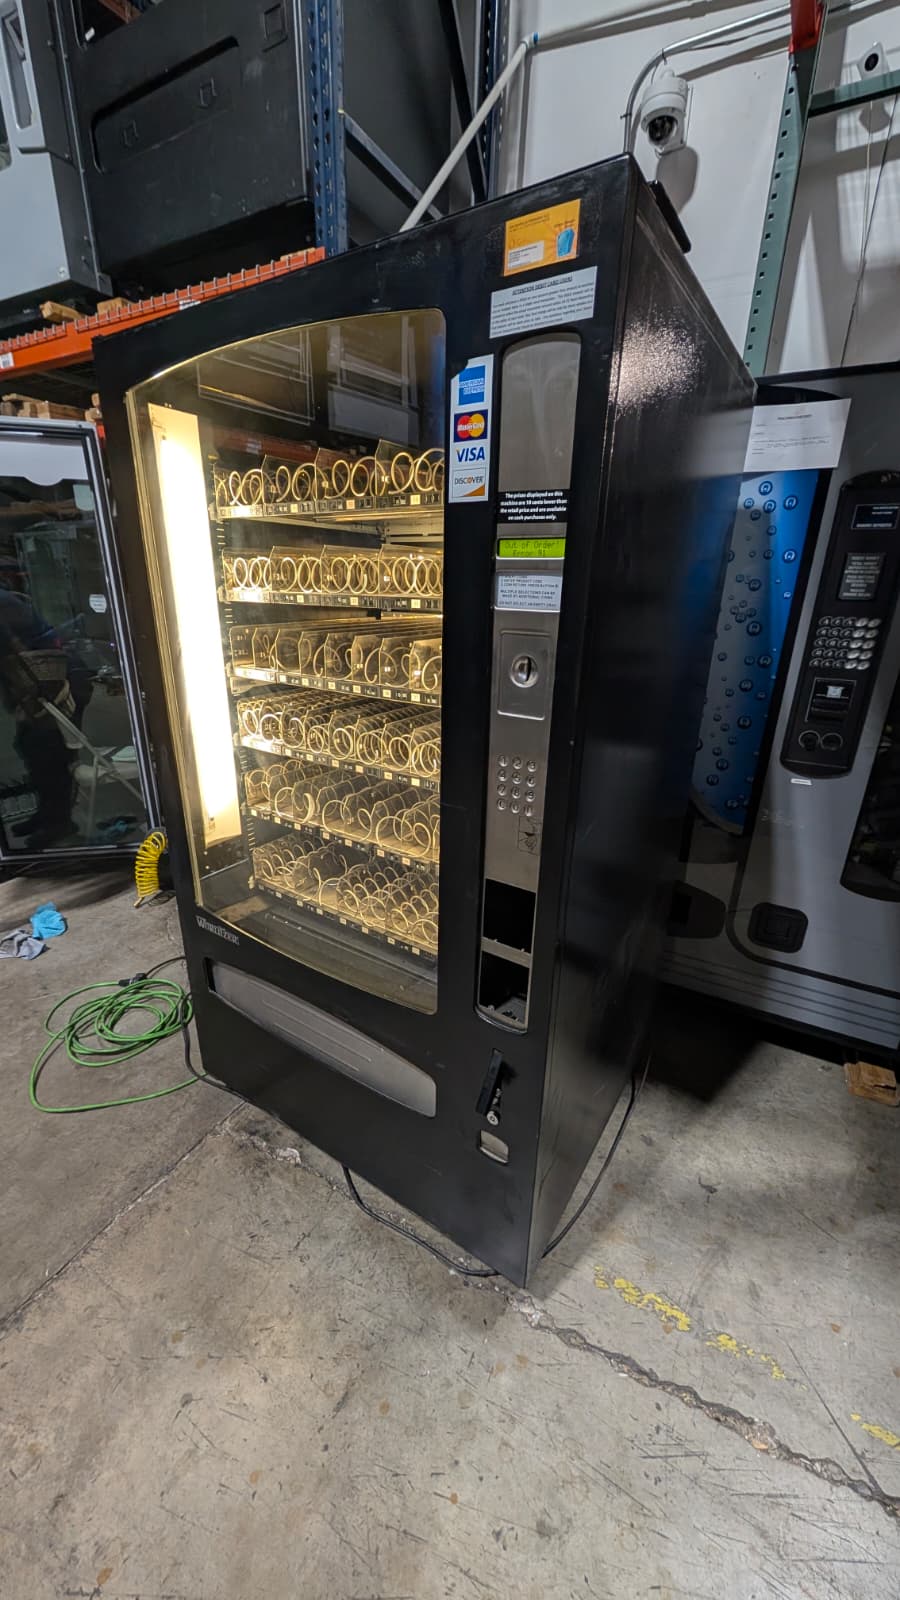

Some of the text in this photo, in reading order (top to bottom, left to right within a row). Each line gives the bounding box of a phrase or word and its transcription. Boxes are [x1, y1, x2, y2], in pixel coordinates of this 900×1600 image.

[457, 421, 485, 432] MasterCard
[456, 446, 485, 462] VISA
[455, 476, 484, 485] DISCOVER
